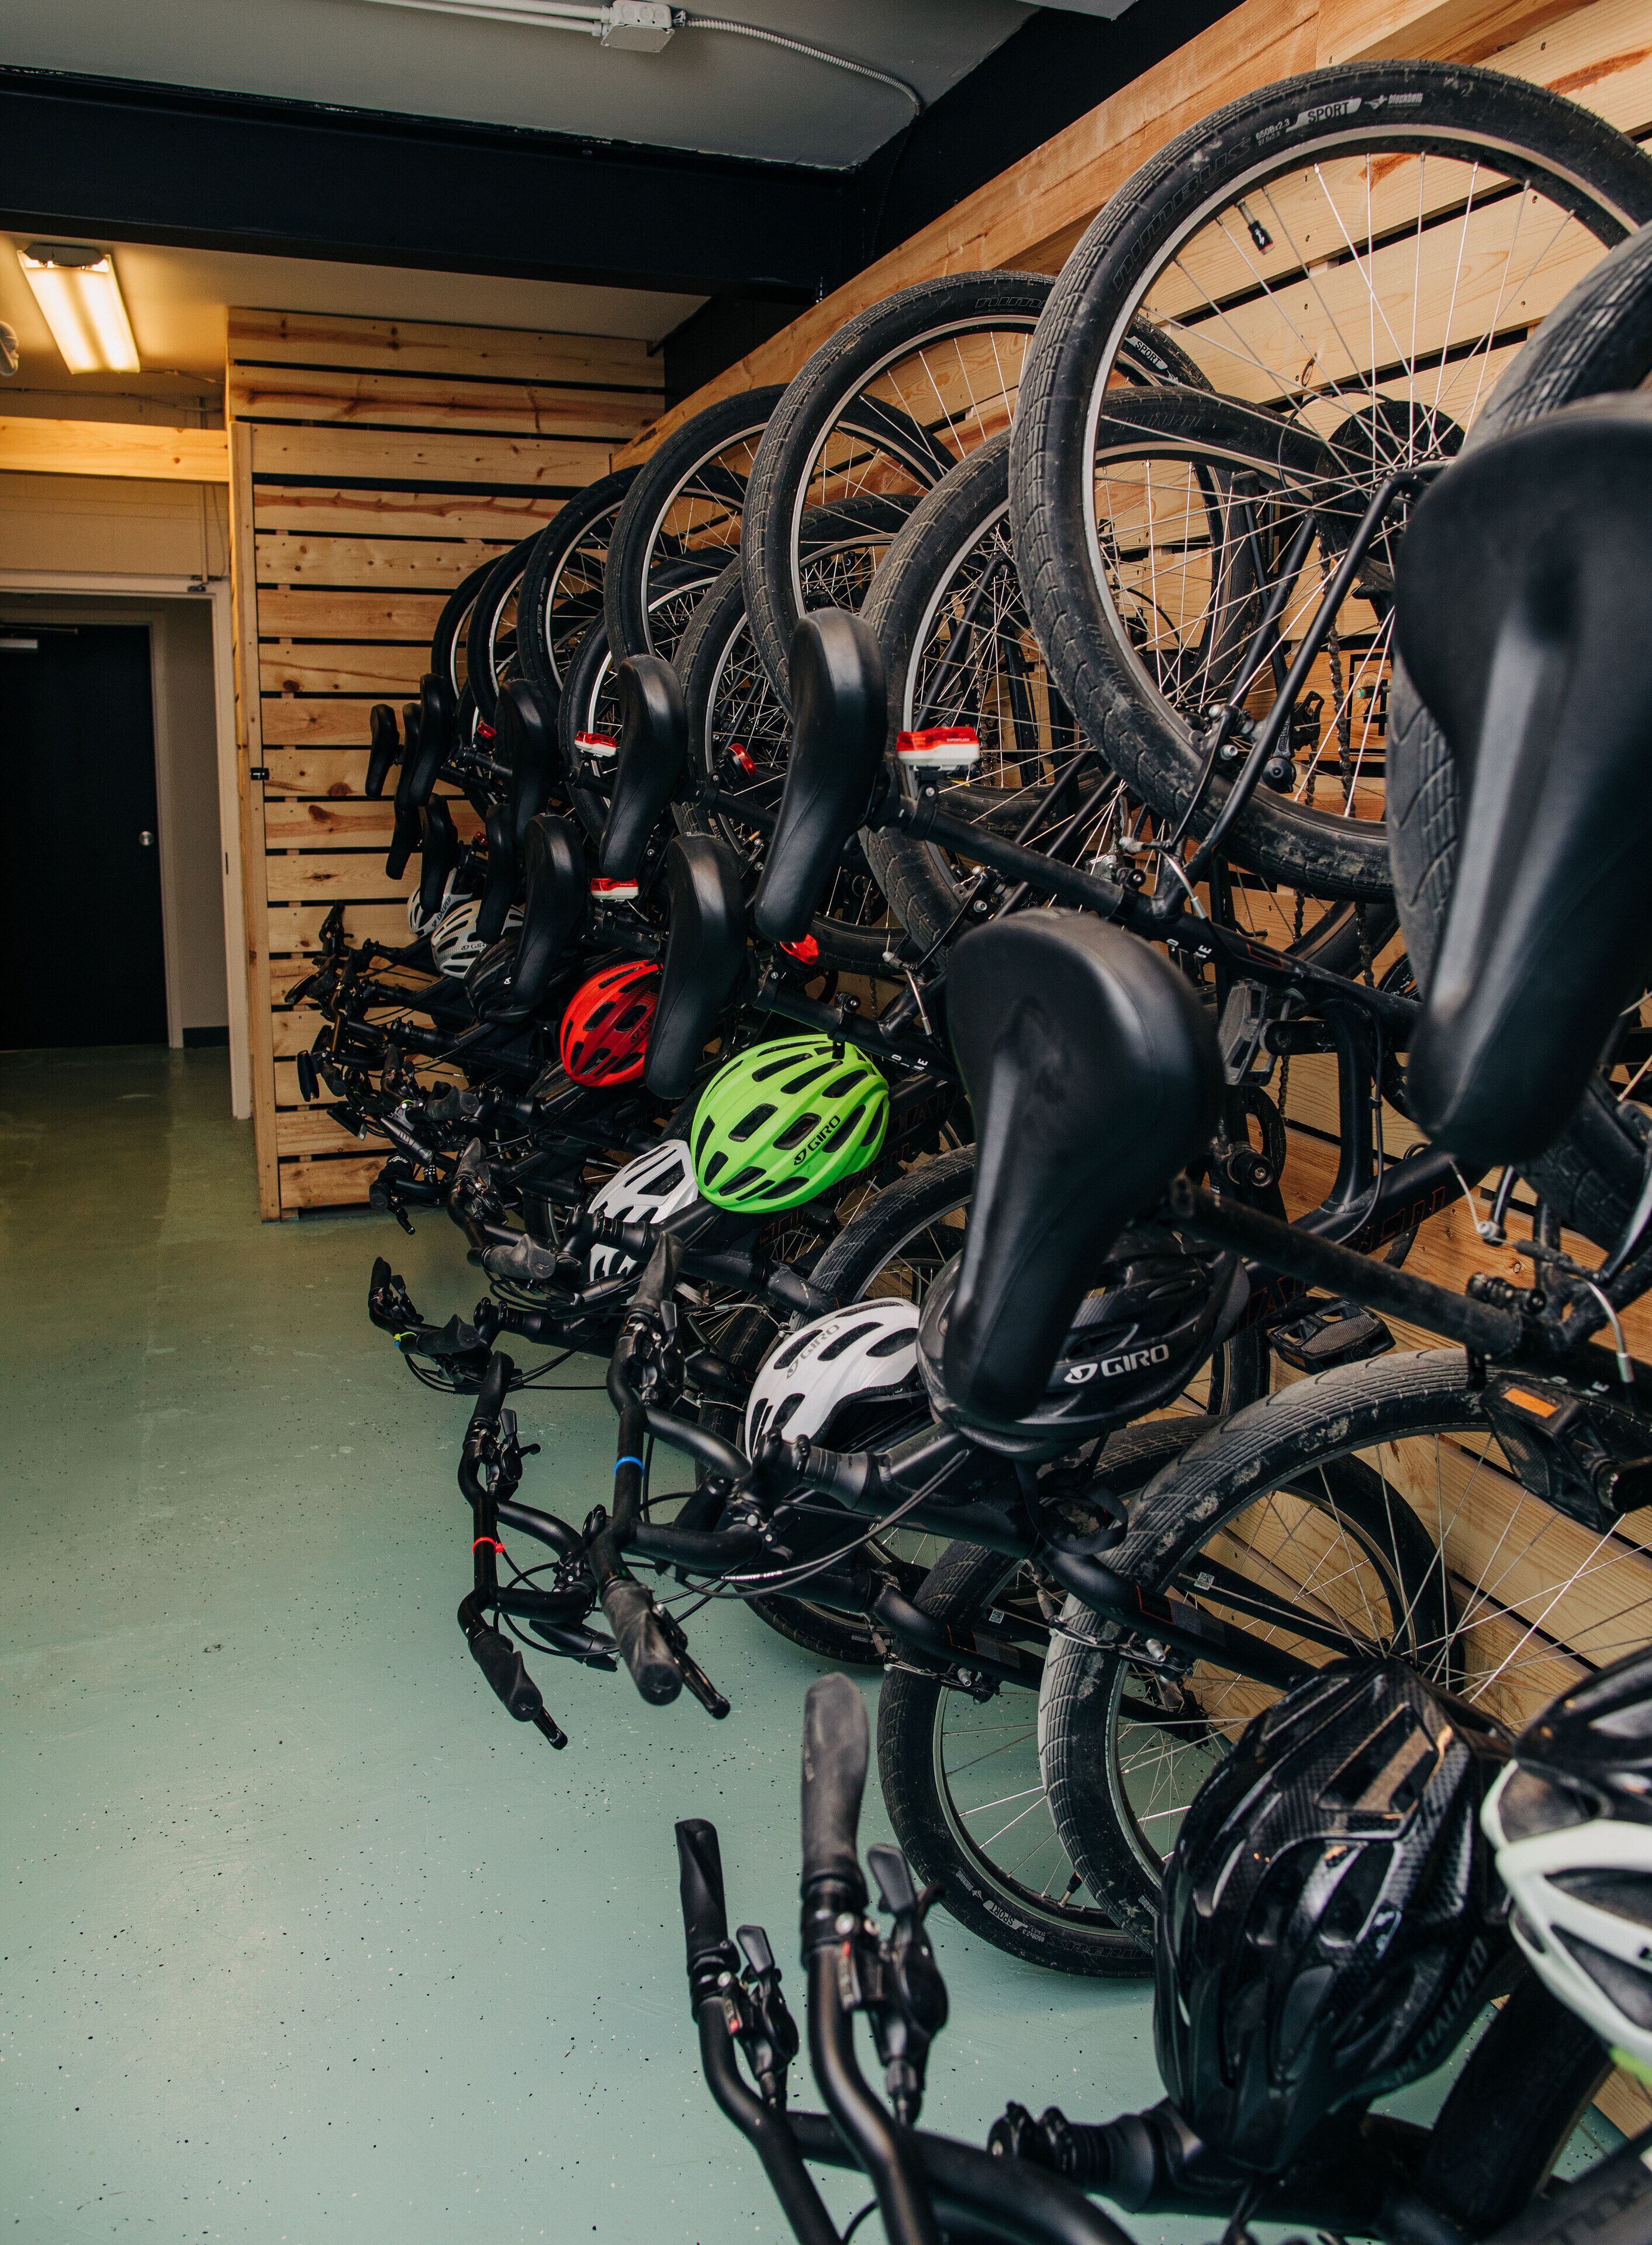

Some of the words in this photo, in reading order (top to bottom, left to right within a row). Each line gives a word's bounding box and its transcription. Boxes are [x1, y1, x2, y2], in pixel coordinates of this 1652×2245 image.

[1307, 101, 1350, 123] SPORT
[1135, 341, 1162, 366] SPORT
[807, 1115, 841, 1151] GIRO
[800, 1324, 840, 1360] GIRO
[1100, 1344, 1170, 1377] GIRO
[989, 1902, 1015, 1926] SPORT
